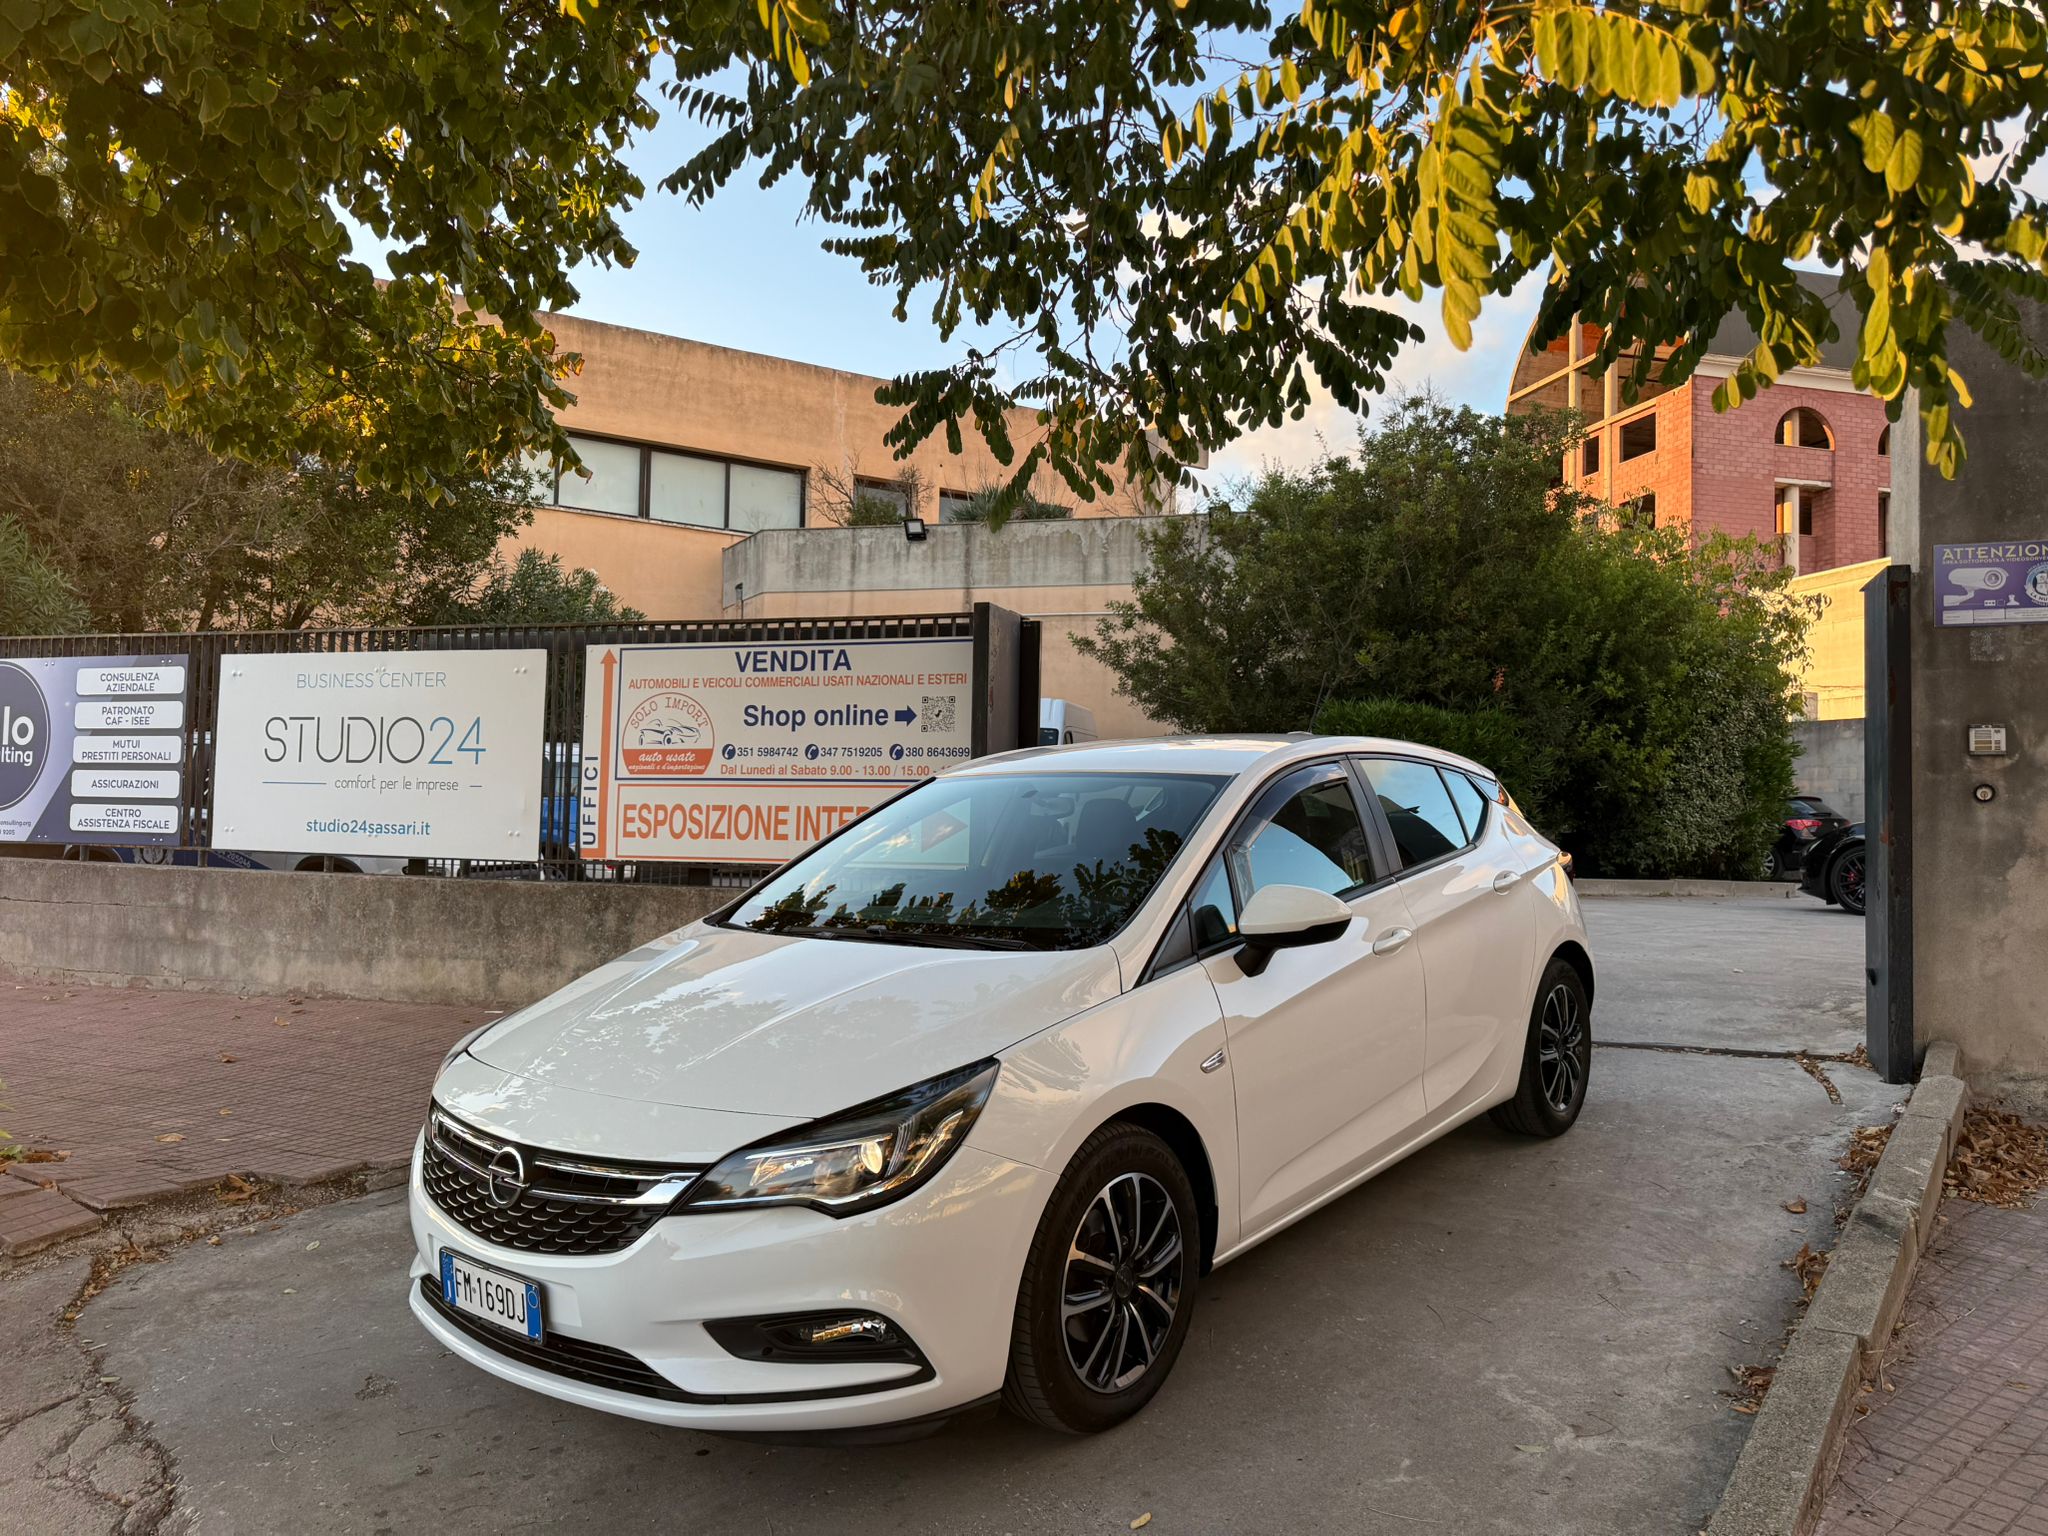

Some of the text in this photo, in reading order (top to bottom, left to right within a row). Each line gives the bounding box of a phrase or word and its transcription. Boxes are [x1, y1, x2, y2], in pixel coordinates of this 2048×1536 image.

[735, 648, 852, 672] VENDITA
[100, 673, 160, 682] CONSULENZA
[296, 672, 446, 689] BUSINESS CENTER
[628, 672, 967, 689] AUTOMOBILI E VEICOLI COMMERCIALI USATI NAZIONALI E ESTERI
[106, 683, 155, 692] AZIENDALE
[102, 706, 154, 715] PATRONATO
[630, 696, 708, 728] SOLO IMPORT
[106, 717, 122, 726] CAF
[131, 717, 150, 725] ISEE
[744, 704, 888, 731] Shop online
[112, 740, 140, 748] MUTUI
[264, 716, 486, 764] STUDIO24
[0, 749, 33, 766] lting
[82, 752, 171, 760] PRESTITI PERSONALI
[639, 750, 696, 762] auto usate
[737, 747, 798, 756] 351 5984742
[820, 747, 882, 756] 347 7519205
[906, 747, 970, 756] 380 8643699
[720, 764, 737, 774] Dal
[778, 764, 788, 775] al
[791, 764, 827, 775] Sabato
[830, 765, 852, 775] 9.00
[863, 766, 890, 776] 13.00
[902, 766, 930, 776] 15.00
[92, 780, 159, 789] ASSICURAZIONI
[334, 774, 458, 795] comfort per le imprese
[583, 756, 598, 845] UFFICI
[105, 808, 142, 818] CENTRO
[77, 819, 170, 829] ASSISTENZA FISCALE
[306, 819, 430, 836] studio24sassari.it
[622, 803, 872, 841] ESPOSIZIONE INTE
